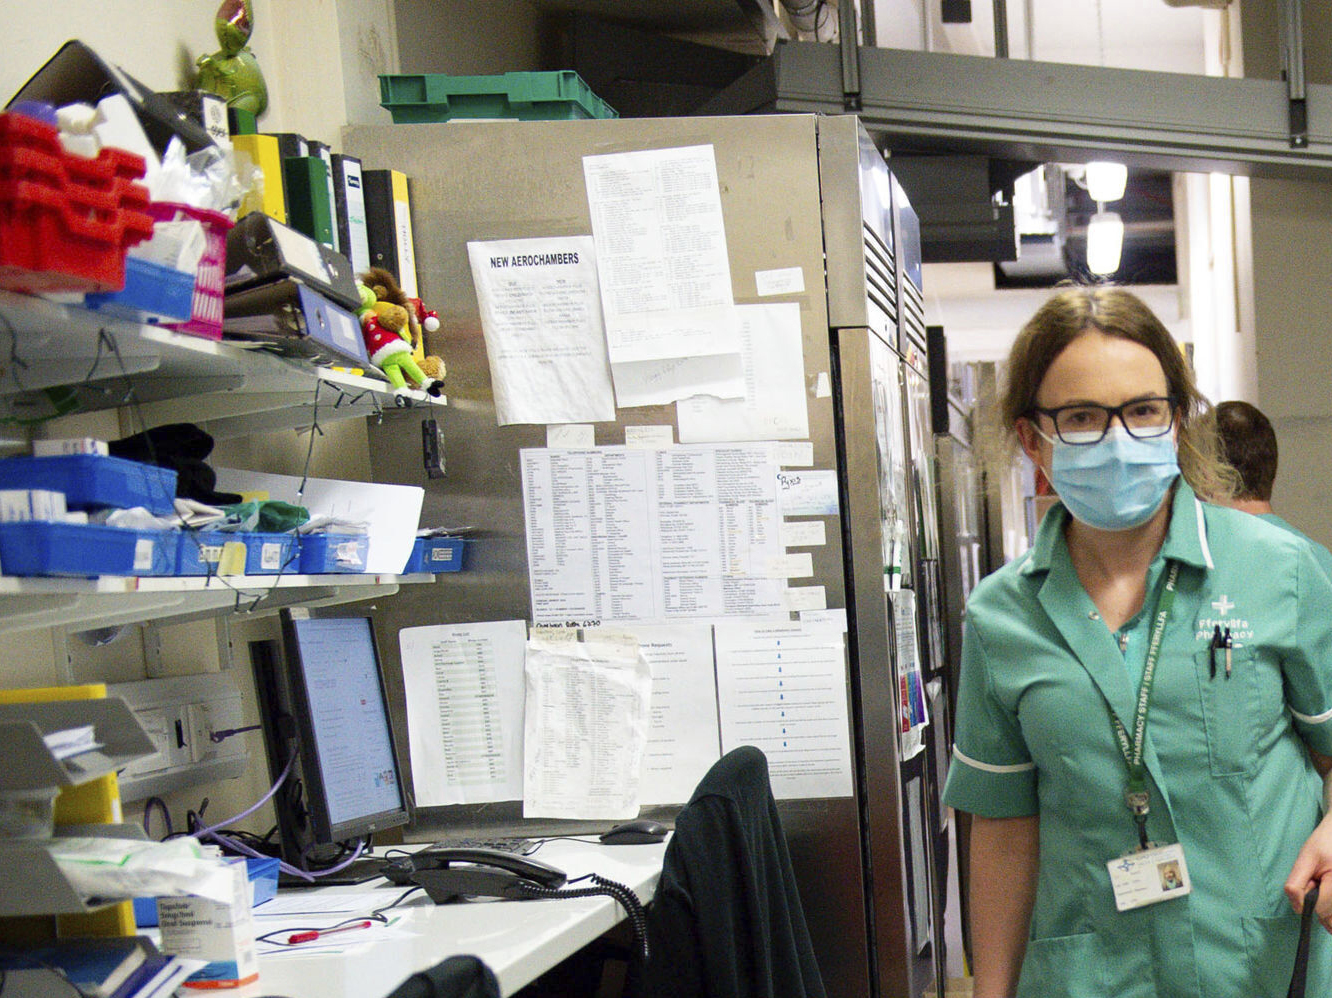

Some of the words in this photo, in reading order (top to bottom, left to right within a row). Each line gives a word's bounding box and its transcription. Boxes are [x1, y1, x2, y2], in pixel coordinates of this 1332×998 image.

[490, 256, 509, 268] NEW
[511, 252, 580, 267] AEROCHAMBERS
[1150, 611, 1168, 658] FFERYLLFA
[1144, 658, 1157, 682] STAFF
[1138, 687, 1151, 714] STAFF
[1133, 714, 1146, 766] PHARMACY
